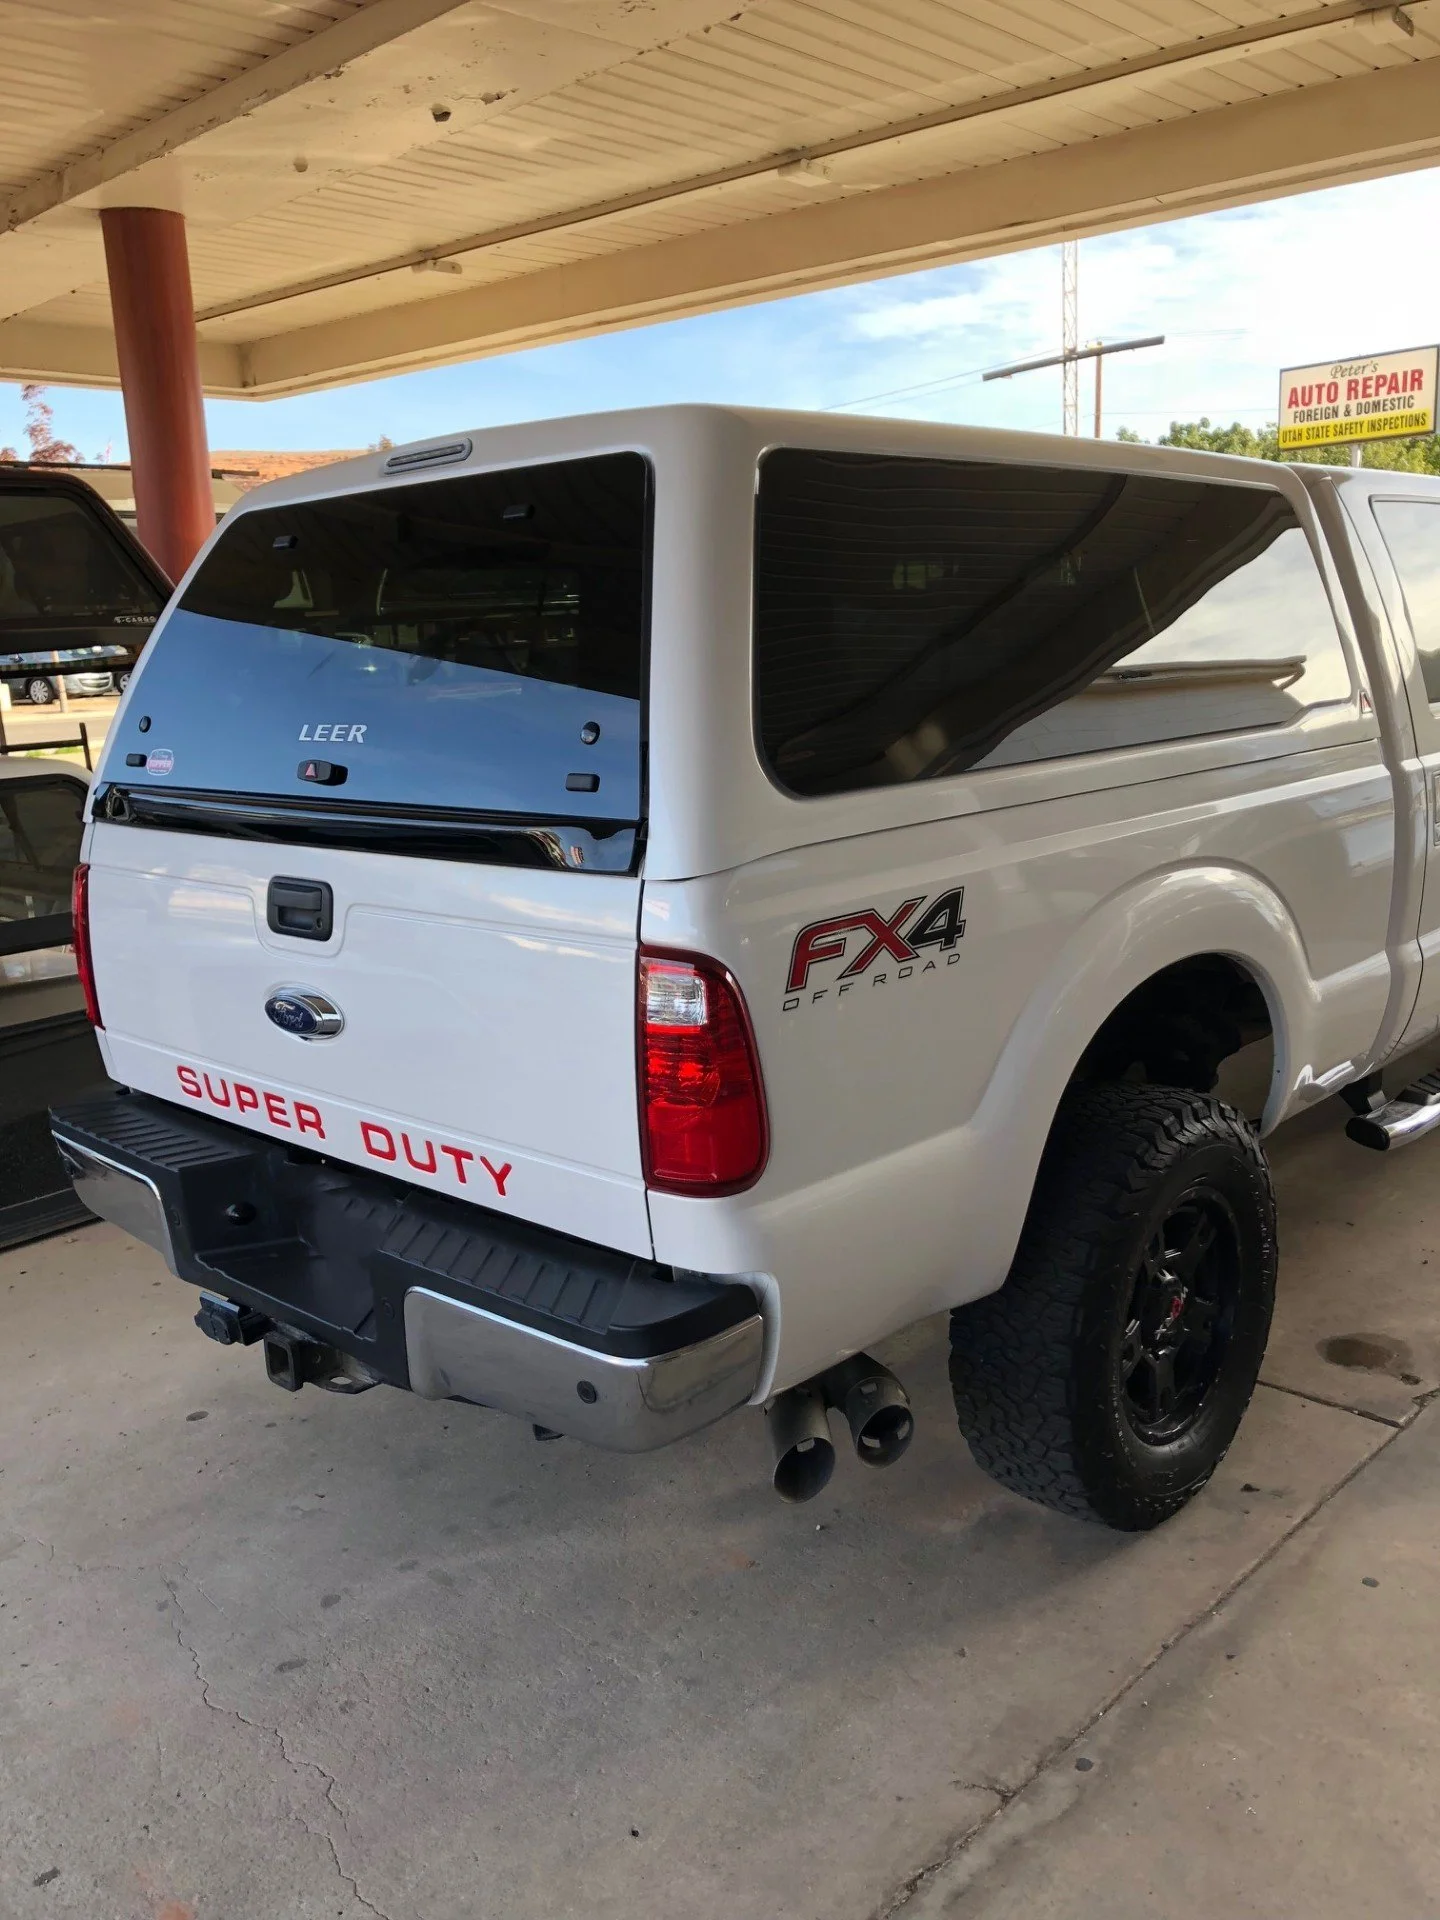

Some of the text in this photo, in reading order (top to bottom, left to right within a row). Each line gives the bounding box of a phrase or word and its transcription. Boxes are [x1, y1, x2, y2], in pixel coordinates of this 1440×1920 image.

[1330, 361, 1378, 379] Peter's
[1287, 369, 1424, 409] AUTO REPAIR
[1293, 395, 1415, 424] FOREIGN & DOMESTIC
[1282, 413, 1427, 443] UTAH STATE SAFETY INSPECTIONS
[298, 724, 368, 744] LEER
[784, 886, 967, 995] FX4
[783, 953, 961, 1011] OFF ROAD
[176, 1064, 513, 1197] SUPER DUTY
